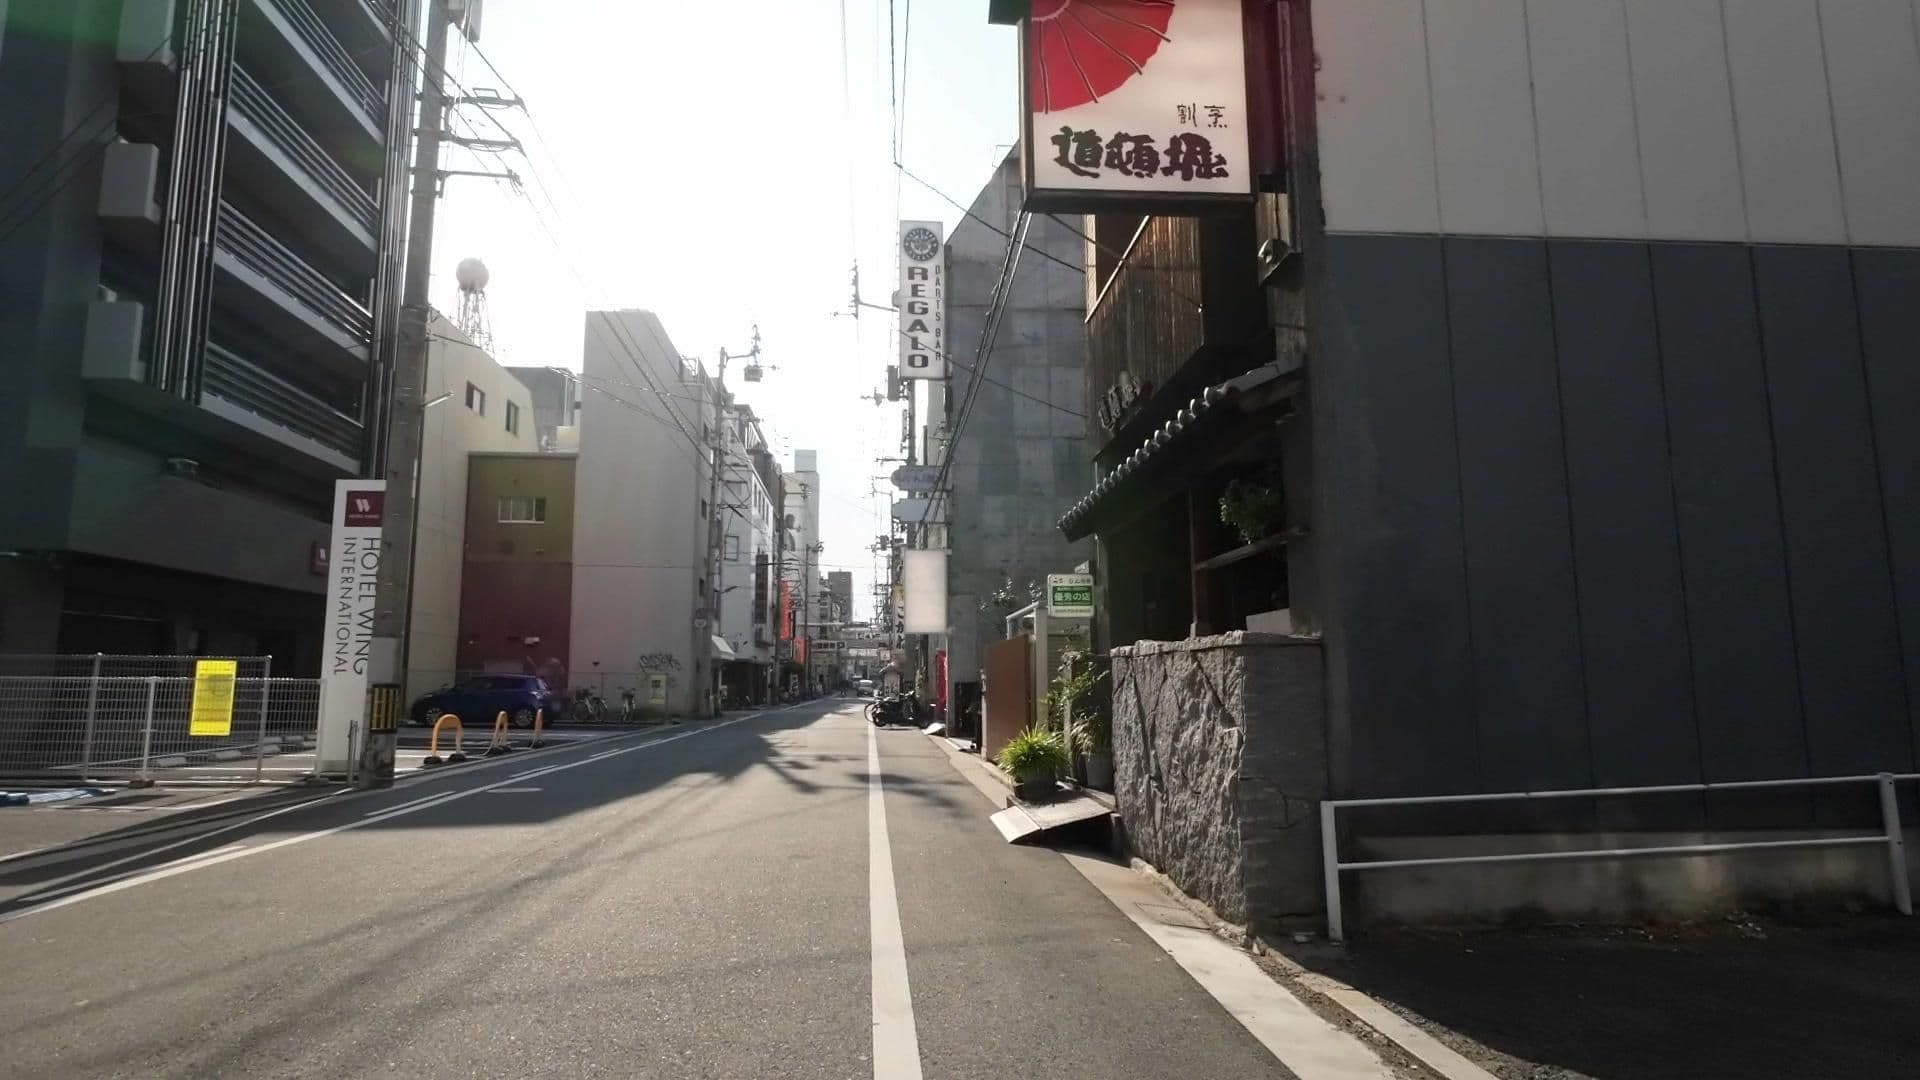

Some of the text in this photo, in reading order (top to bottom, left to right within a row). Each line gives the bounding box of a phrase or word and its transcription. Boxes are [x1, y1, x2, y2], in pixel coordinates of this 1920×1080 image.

[1050, 125, 1230, 182] 道頓堀
[906, 266, 931, 369] REGALO
[934, 265, 942, 361] DARTS BAR
[333, 537, 357, 675] INTERNATIONAL
[352, 608, 376, 675] WING
